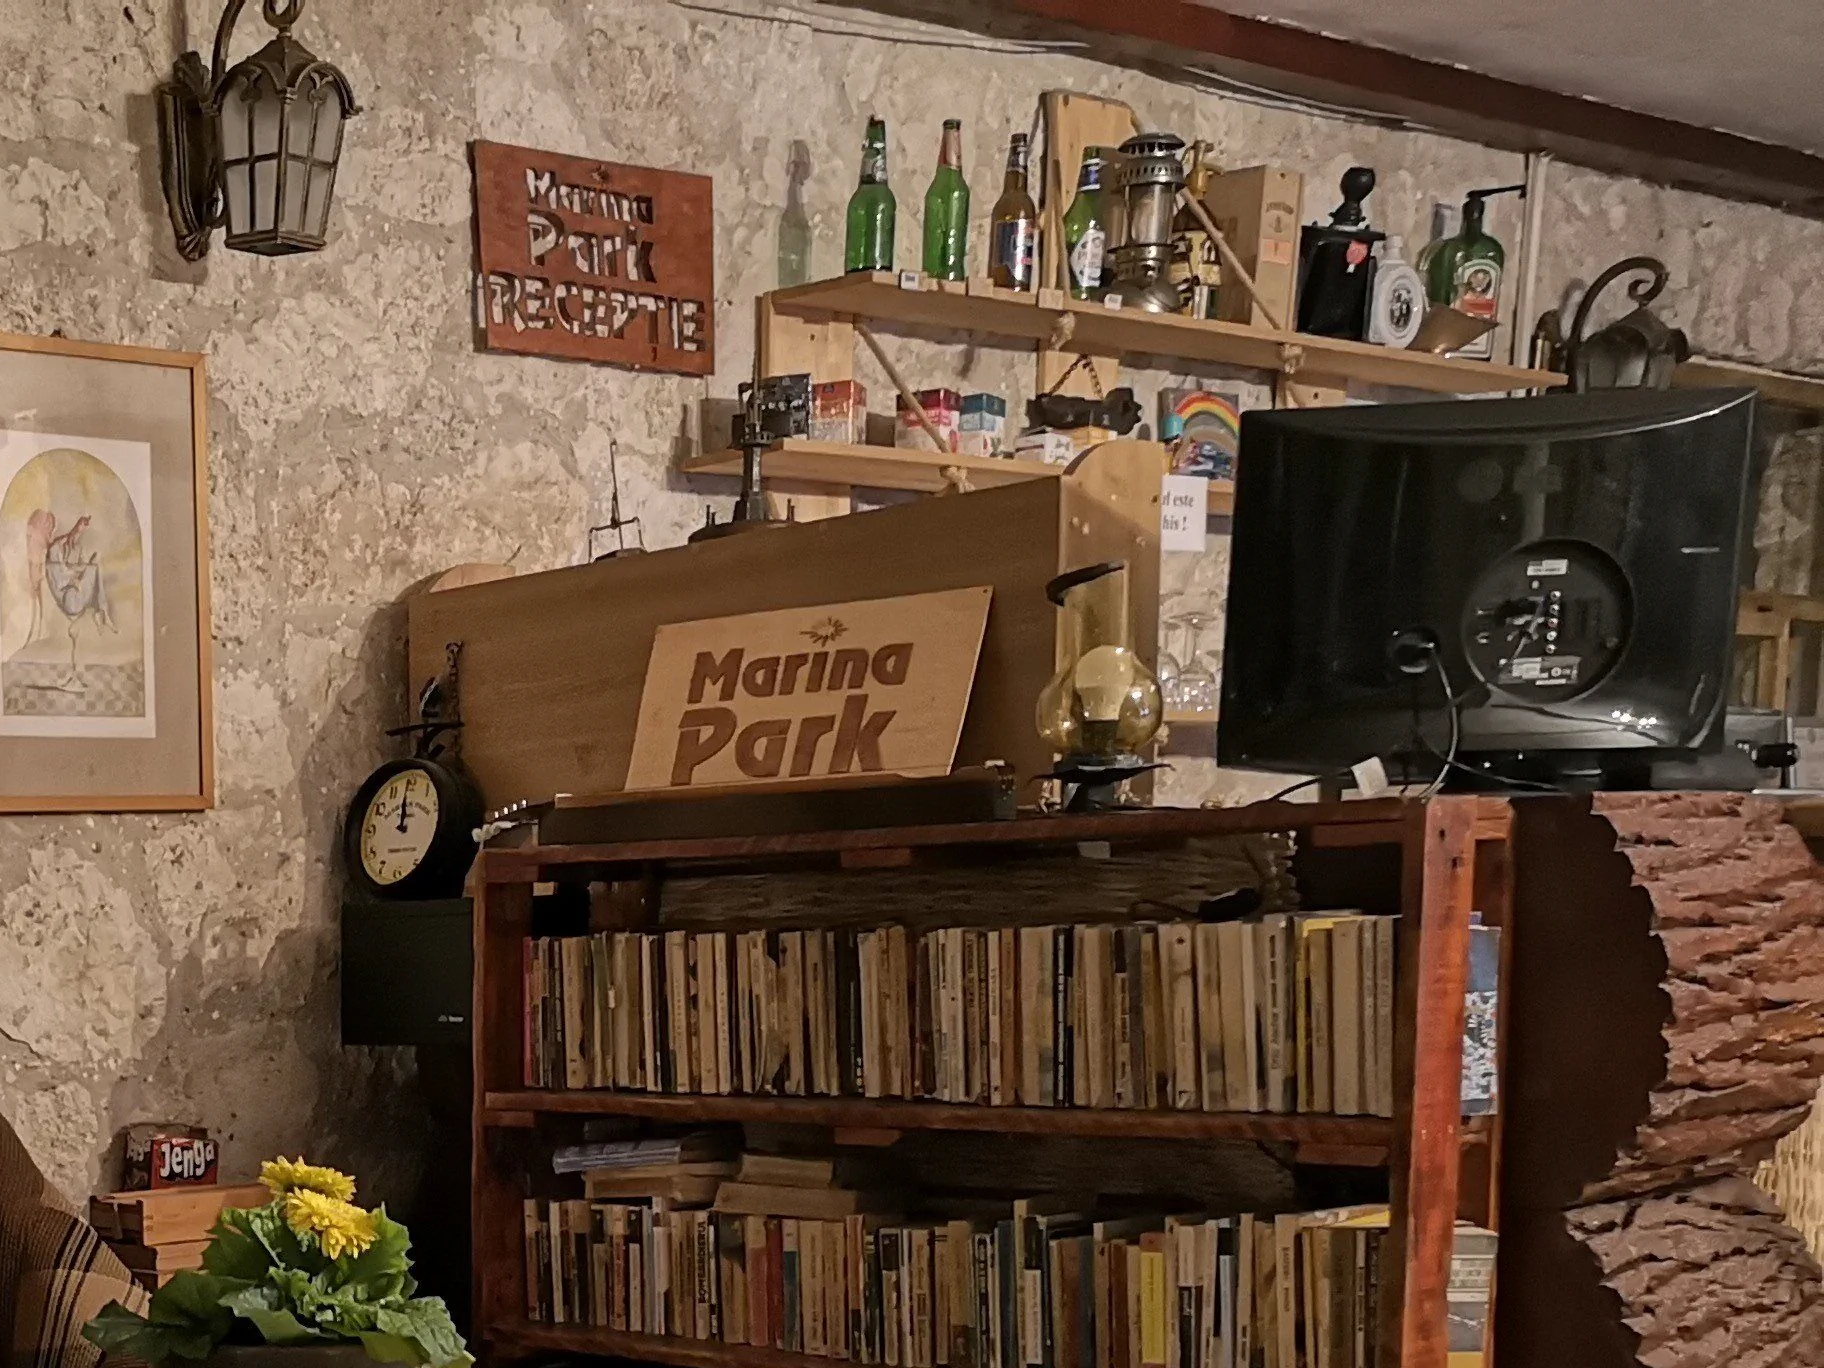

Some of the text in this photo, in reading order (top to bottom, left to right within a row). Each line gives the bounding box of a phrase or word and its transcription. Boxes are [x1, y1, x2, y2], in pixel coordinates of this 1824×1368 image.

[527, 210, 658, 284] Park
[687, 641, 914, 704] Marina
[671, 693, 897, 786] Park
[159, 1140, 215, 1178] Jenga
